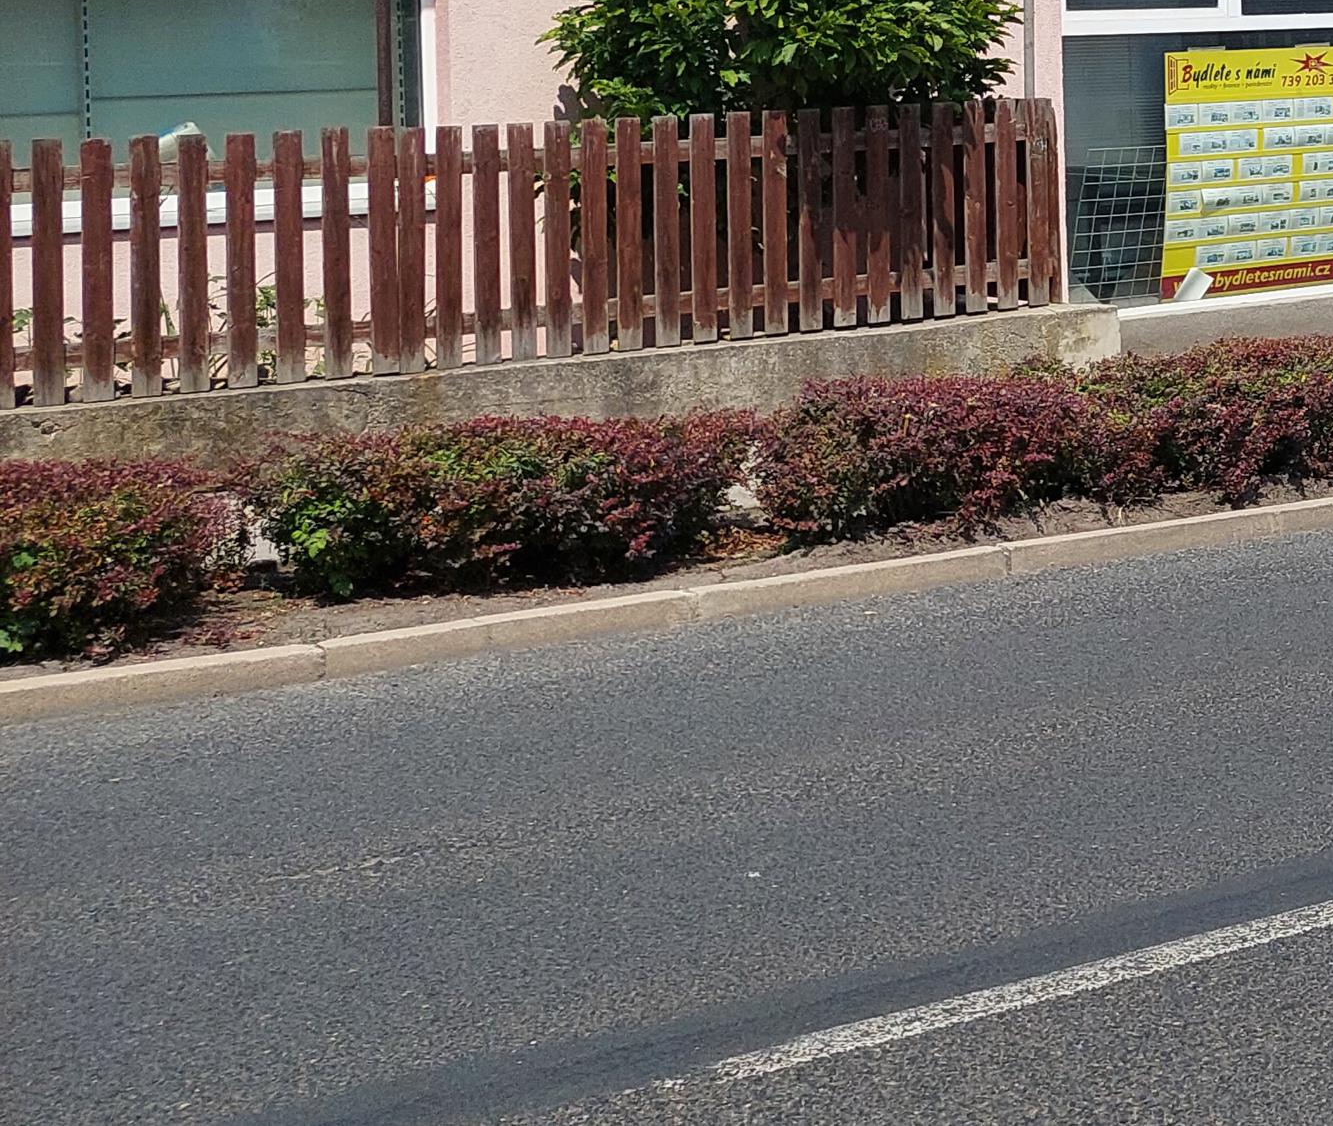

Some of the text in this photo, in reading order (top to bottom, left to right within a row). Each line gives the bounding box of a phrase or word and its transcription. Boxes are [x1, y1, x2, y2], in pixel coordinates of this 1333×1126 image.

[1182, 63, 1231, 88] Bydlete
[1235, 69, 1241, 81] s
[1245, 61, 1277, 80] námi
[1281, 75, 1300, 87] 739
[1305, 74, 1325, 86] 203
[1173, 263, 1331, 293] .bydletesnami.cz
